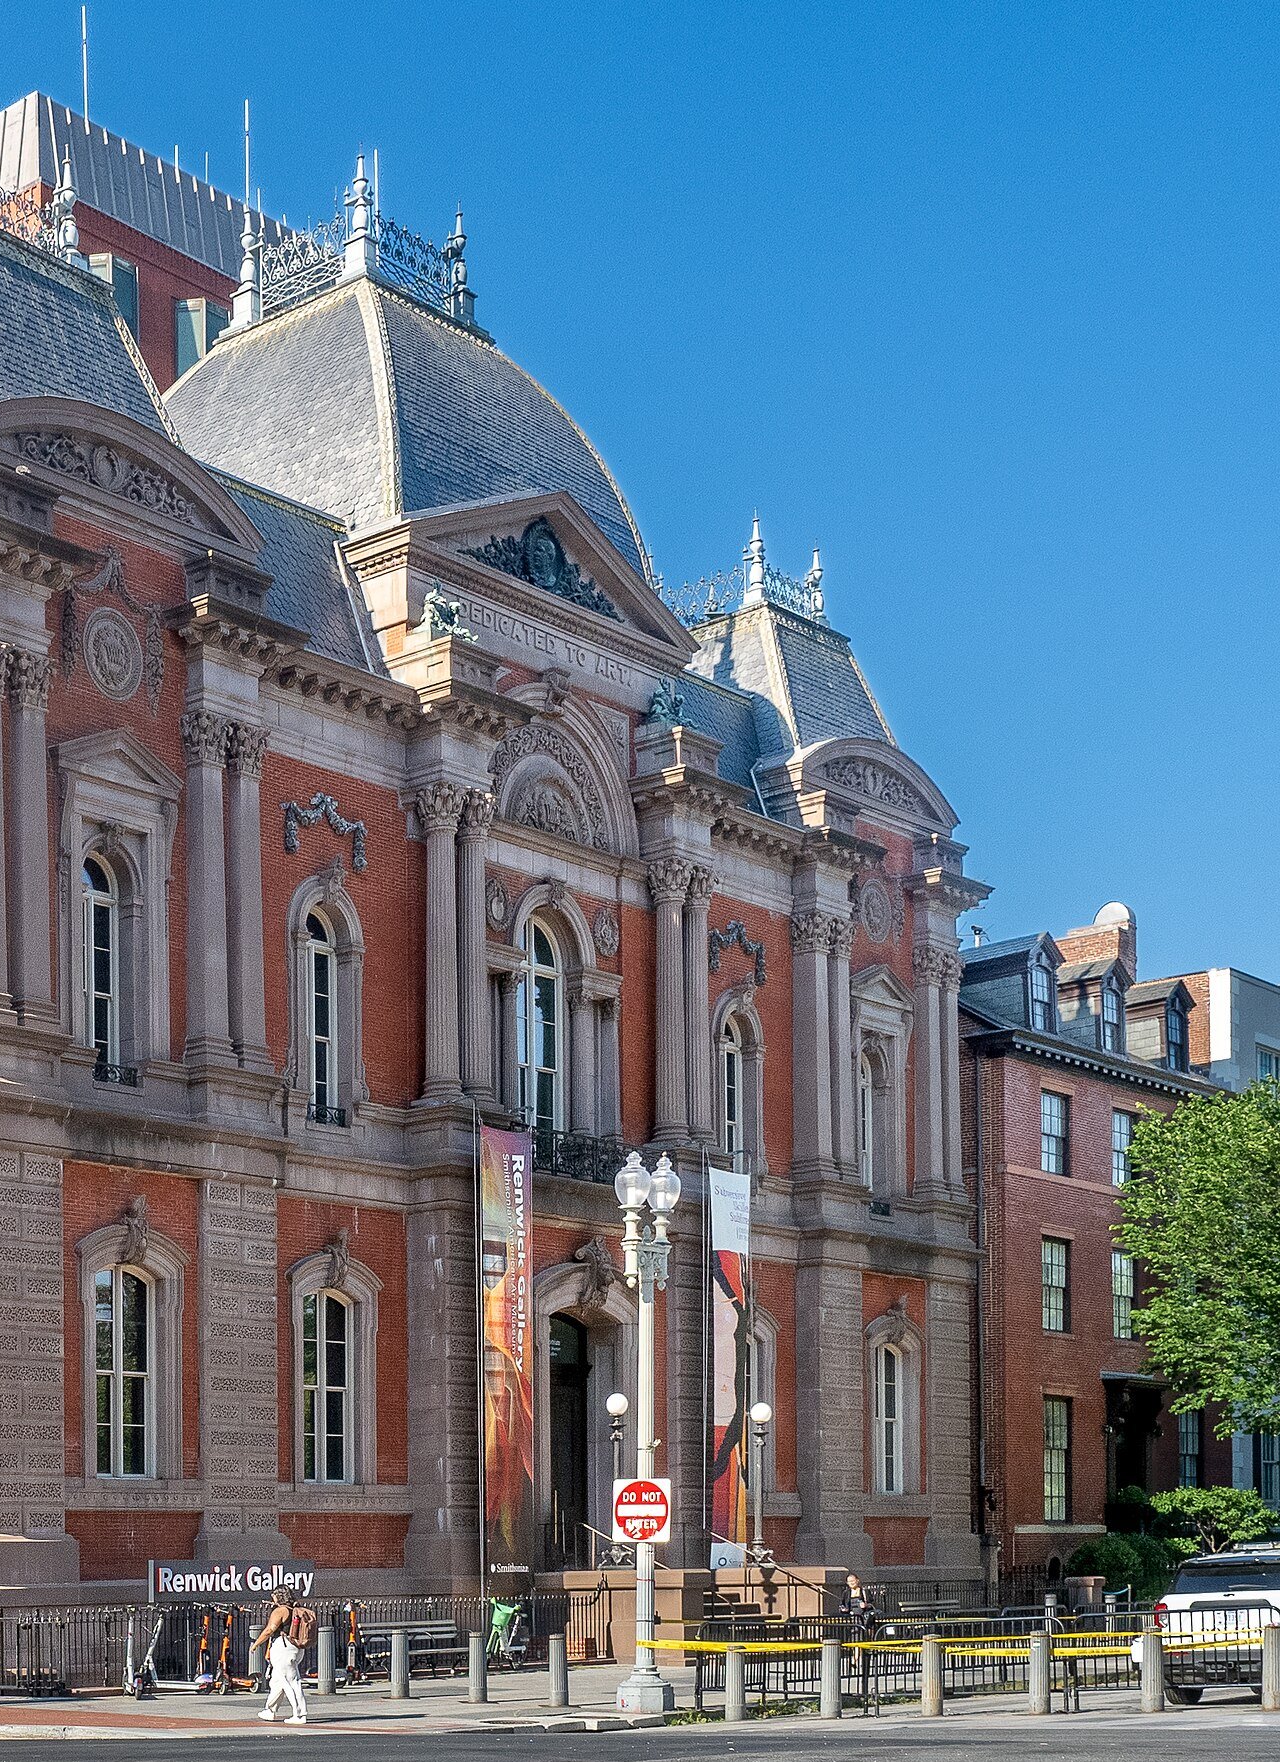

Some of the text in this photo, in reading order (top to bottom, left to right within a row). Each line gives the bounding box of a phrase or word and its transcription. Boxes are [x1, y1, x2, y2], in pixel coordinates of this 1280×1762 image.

[459, 599, 556, 655] DEDICATED
[565, 644, 586, 668] TO
[502, 1153, 512, 1223] Smithsonian
[510, 1305, 518, 1355] Museum
[511, 1154, 526, 1373] Renwick Gallery
[622, 1491, 662, 1503] DO NOT
[158, 1565, 314, 1597] Renwick Gallery
